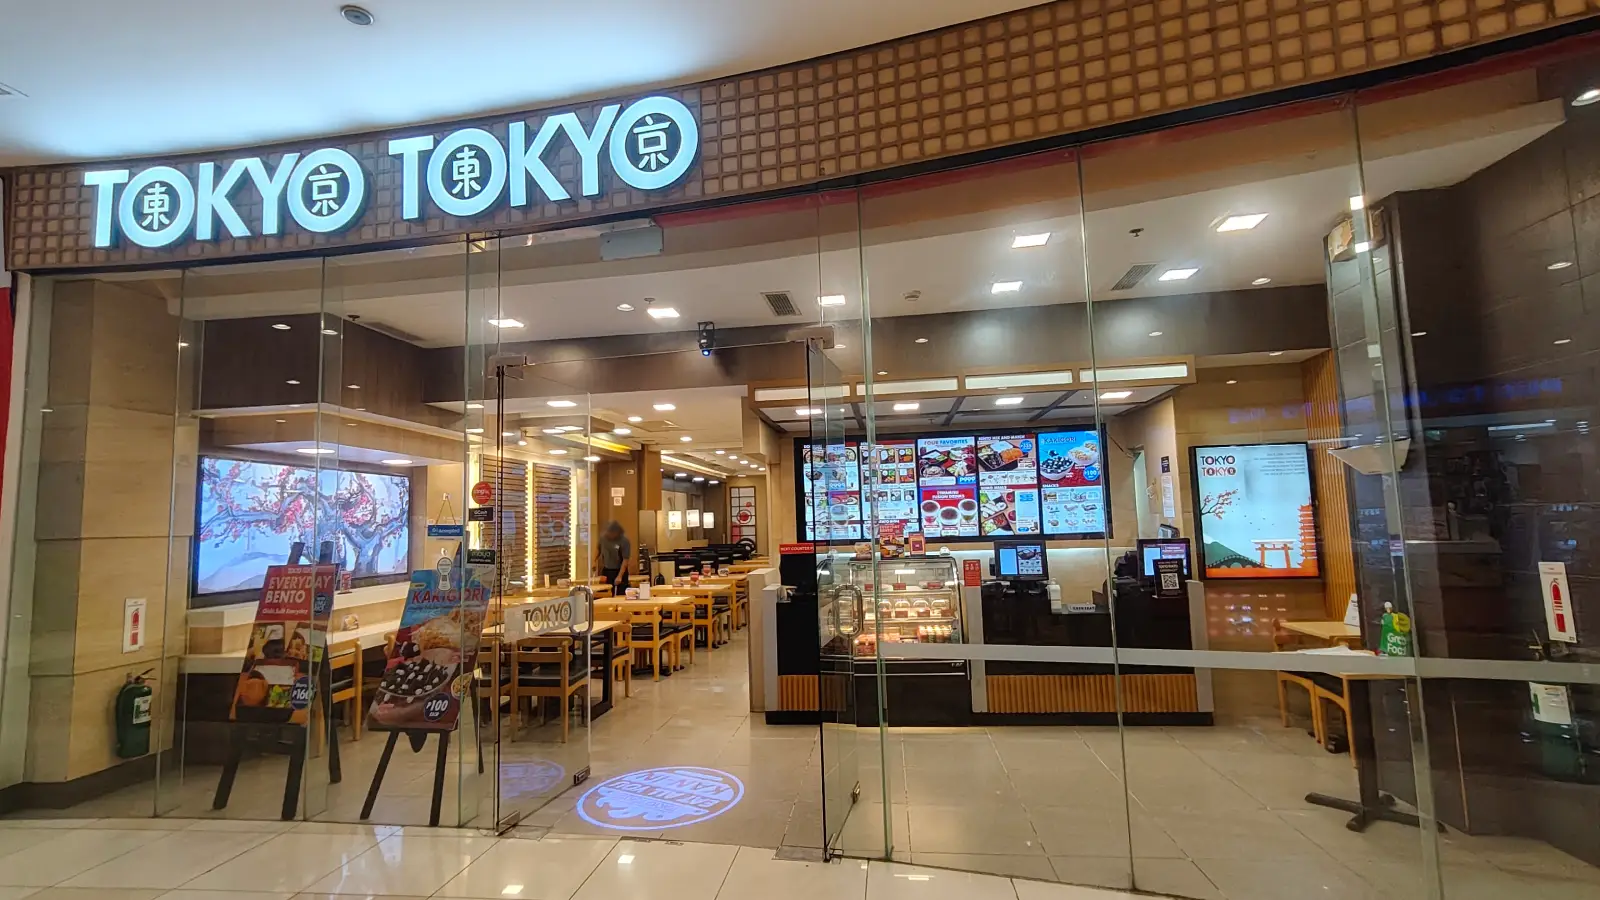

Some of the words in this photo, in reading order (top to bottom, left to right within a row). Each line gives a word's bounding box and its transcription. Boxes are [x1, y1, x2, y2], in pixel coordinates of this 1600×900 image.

[84, 148, 365, 248] TOKYO
[388, 96, 698, 220] TOKYO
[1200, 455, 1235, 465] TOKYO
[1202, 467, 1236, 476] TOKYO
[268, 576, 331, 590] EVERYDAY
[264, 590, 306, 604] BENTO
[523, 601, 572, 634] TOKYO
